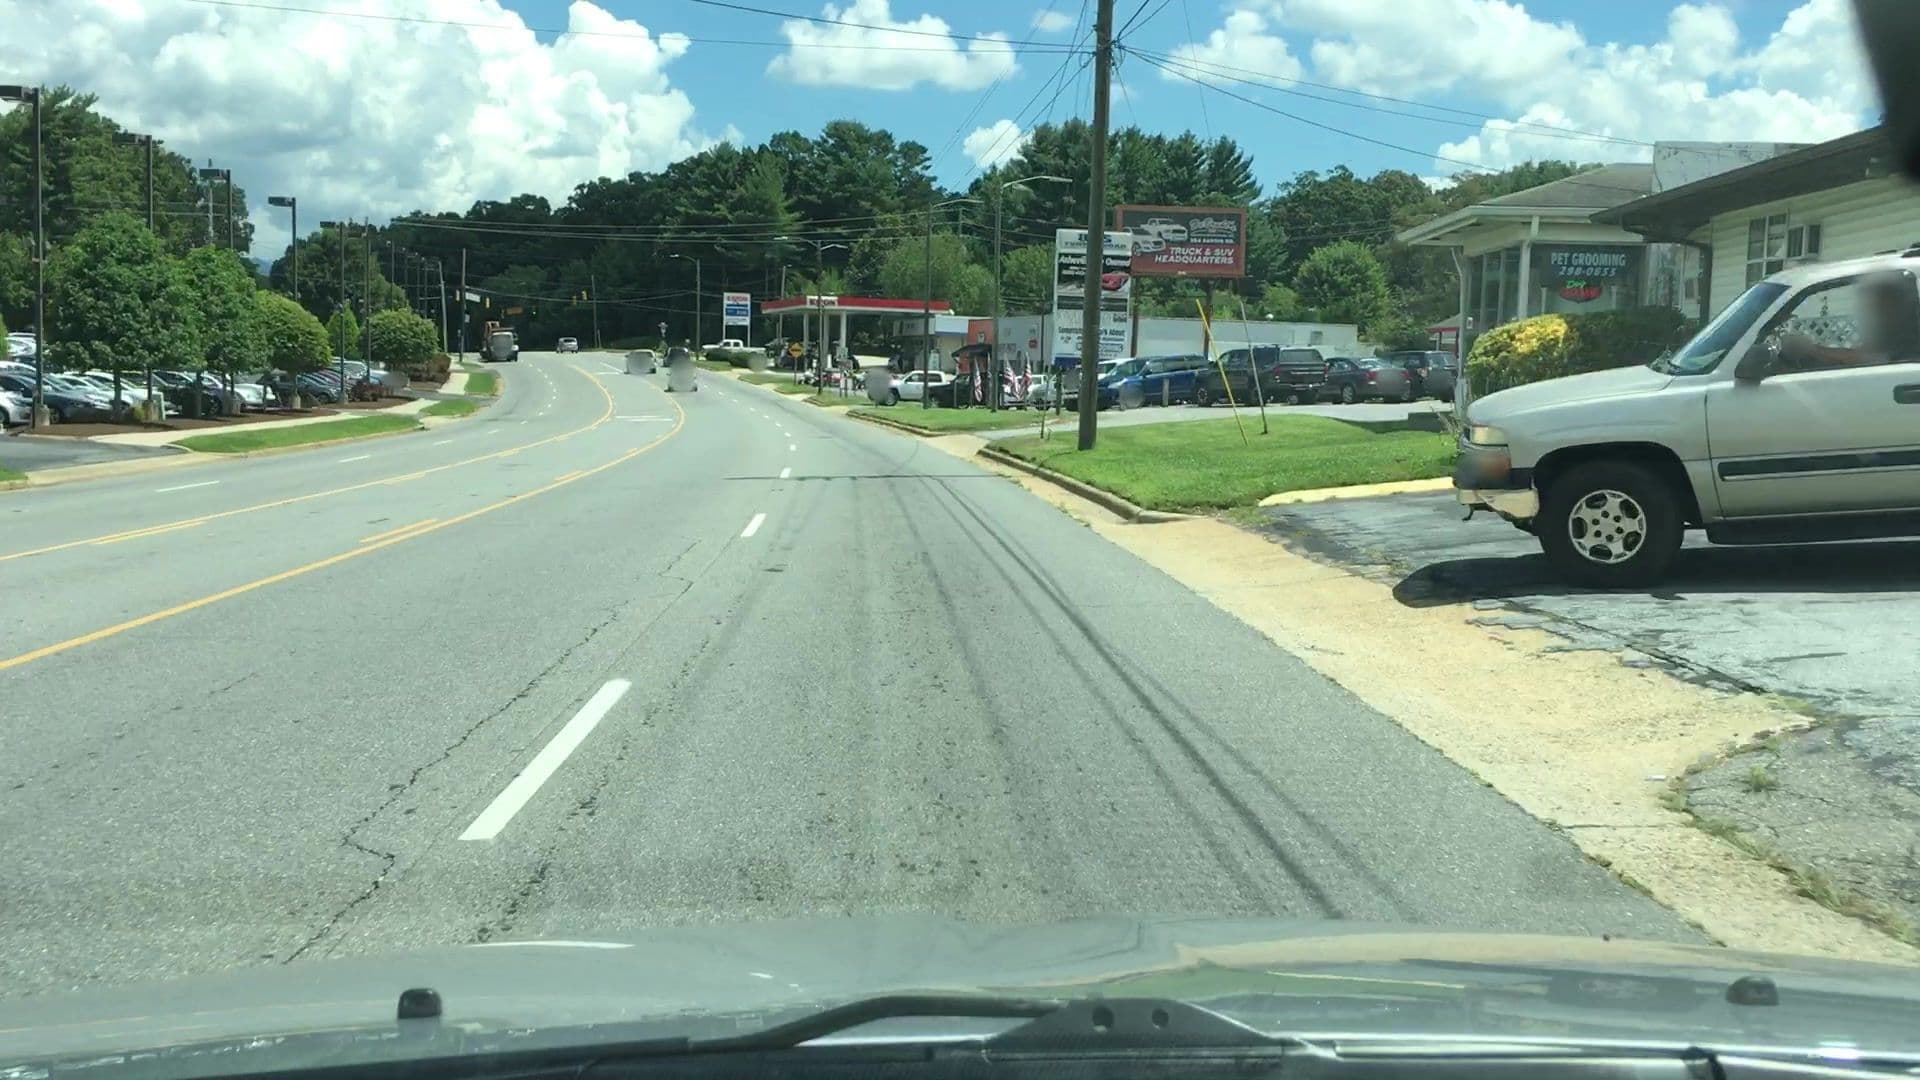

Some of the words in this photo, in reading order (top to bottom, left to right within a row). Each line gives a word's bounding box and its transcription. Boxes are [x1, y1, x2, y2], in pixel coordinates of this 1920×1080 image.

[1170, 247, 1202, 256] TRUCK
[1214, 248, 1234, 256] SUV
[1154, 255, 1234, 265] HEADQUARTERS
[1551, 252, 1569, 265] PET
[1572, 253, 1626, 266] GROOMING
